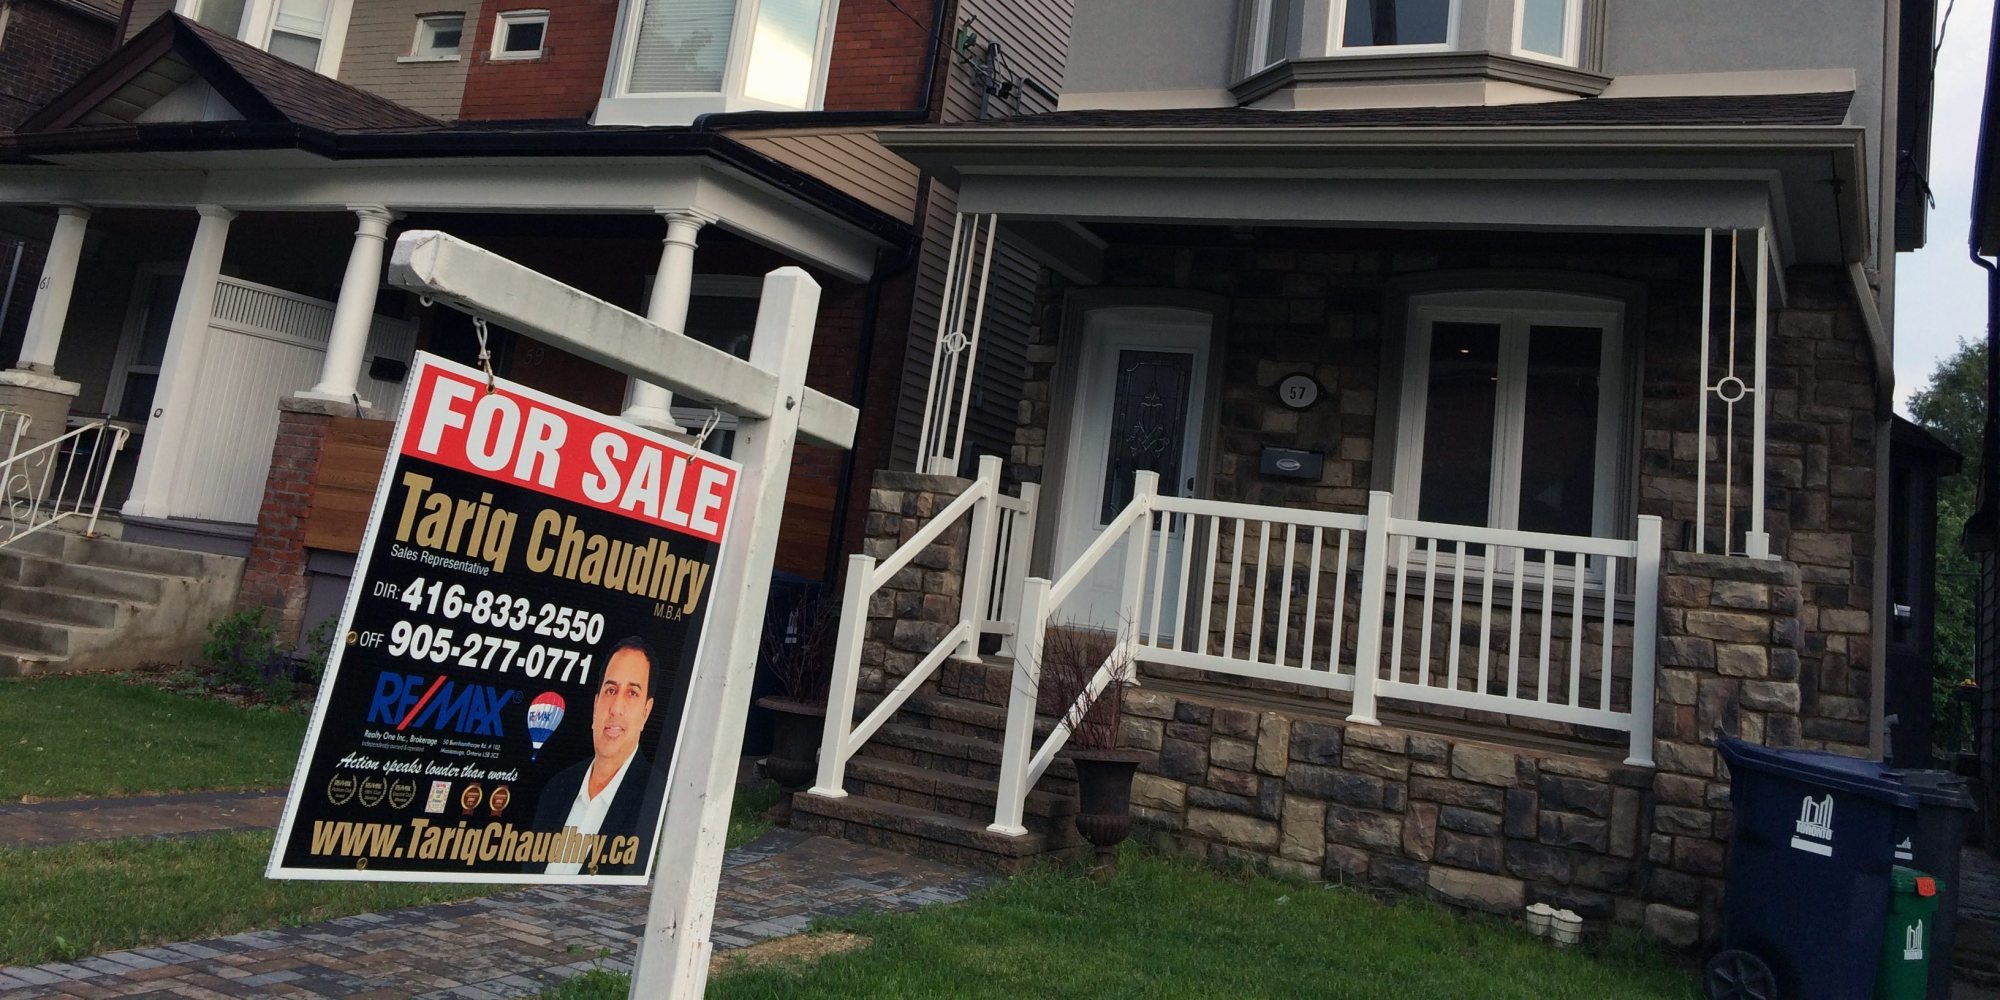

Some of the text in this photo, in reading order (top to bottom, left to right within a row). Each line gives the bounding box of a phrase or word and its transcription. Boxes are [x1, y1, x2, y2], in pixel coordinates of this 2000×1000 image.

[39, 276, 51, 290] 61
[1290, 386, 1306, 400] 57
[418, 375, 729, 536] FOR SALE
[395, 471, 710, 615] Tariq Chaudhry
[391, 544, 490, 577] Sales Representative
[373, 577, 605, 645] DIR: 416-833-2550
[653, 602, 682, 621] M.B.A
[359, 621, 593, 685] OFF 905-277-0771
[363, 729, 383, 741] Realty
[382, 731, 396, 741] One
[409, 734, 438, 747] Brokerage
[336, 751, 519, 782] Action speaks louder than words
[310, 818, 640, 868] www.TariqChaudhry.ca
[1796, 820, 1834, 840] TORONTO
